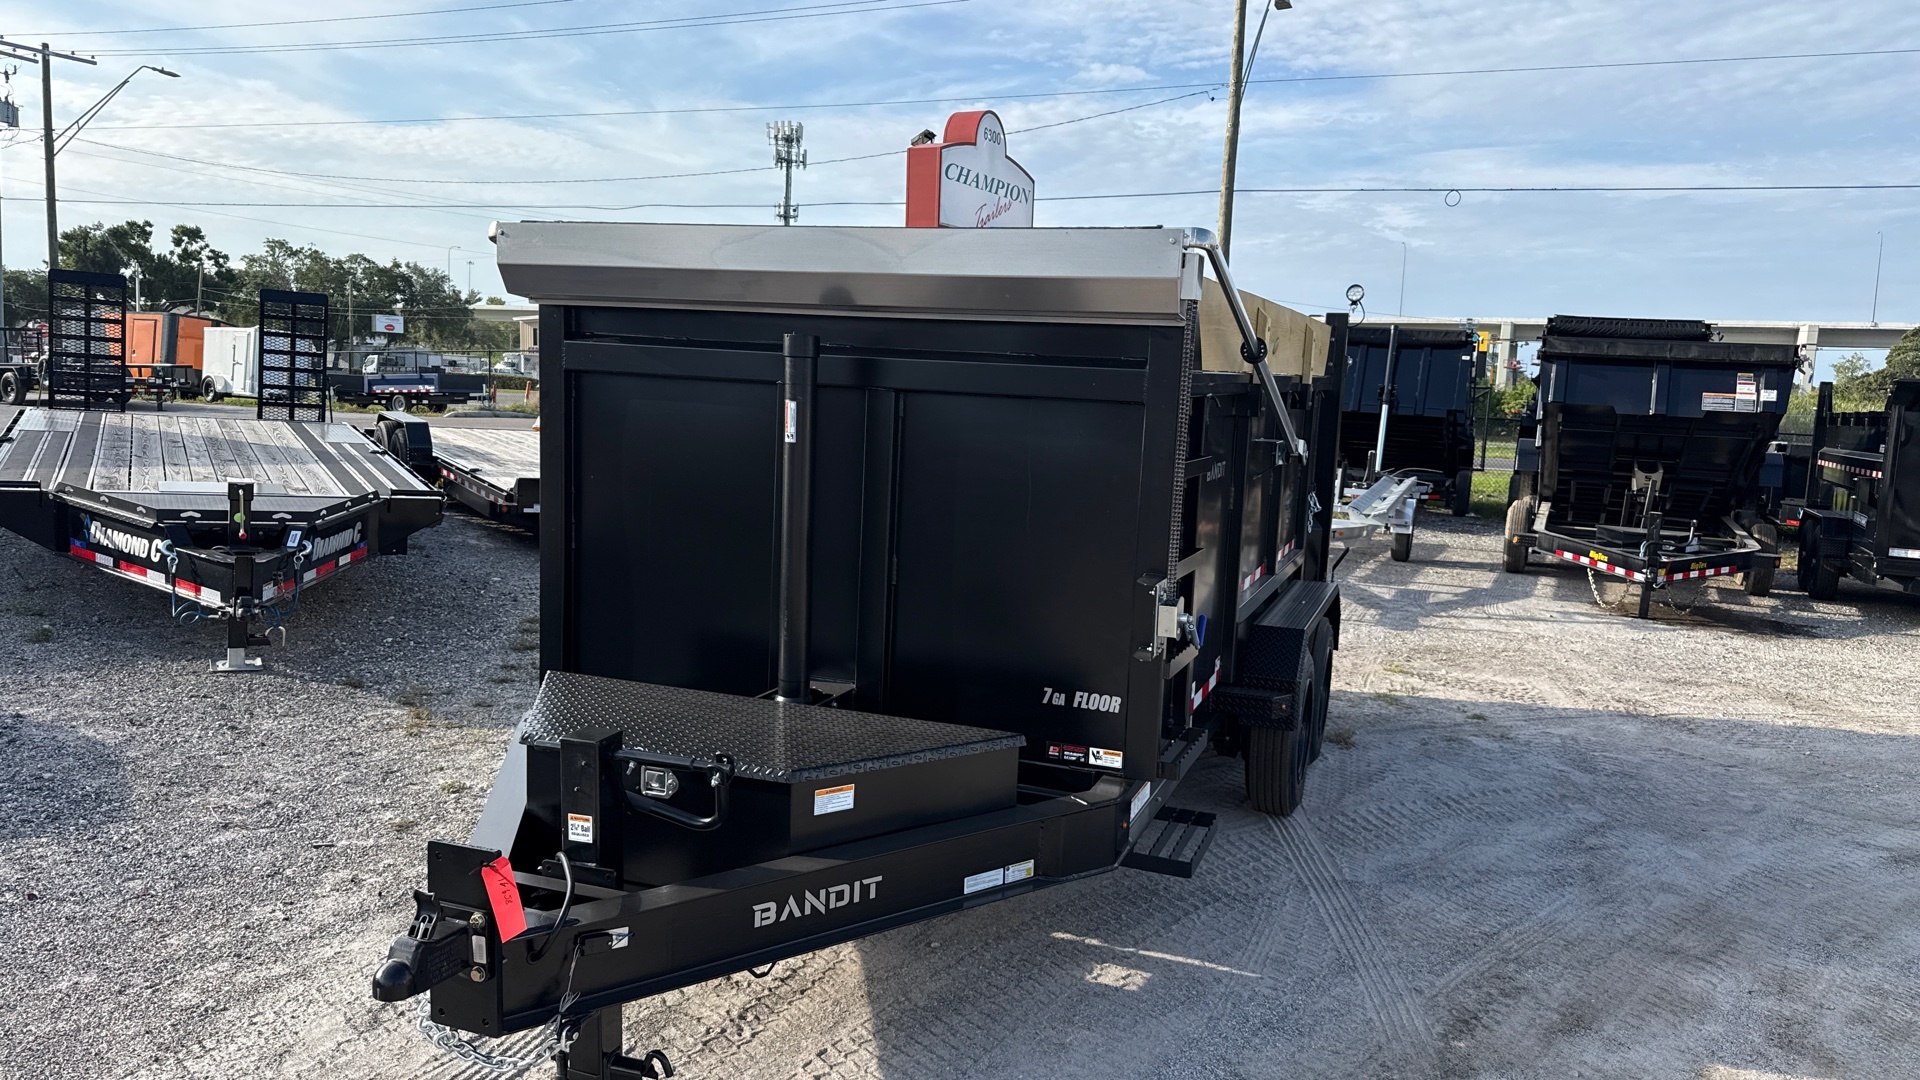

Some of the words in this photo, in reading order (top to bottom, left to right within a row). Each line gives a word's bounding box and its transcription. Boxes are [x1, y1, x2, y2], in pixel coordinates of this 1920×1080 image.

[983, 126, 1001, 145] 6300
[944, 162, 1031, 205] CHAMPION
[975, 196, 1012, 228] Trailers
[89, 520, 149, 558] DIAMOND
[150, 538, 162, 563] C
[312, 528, 354, 562] DIAMOND
[353, 521, 362, 544] C
[1073, 691, 1122, 714] FLOOR
[752, 875, 883, 928] BANDIT
